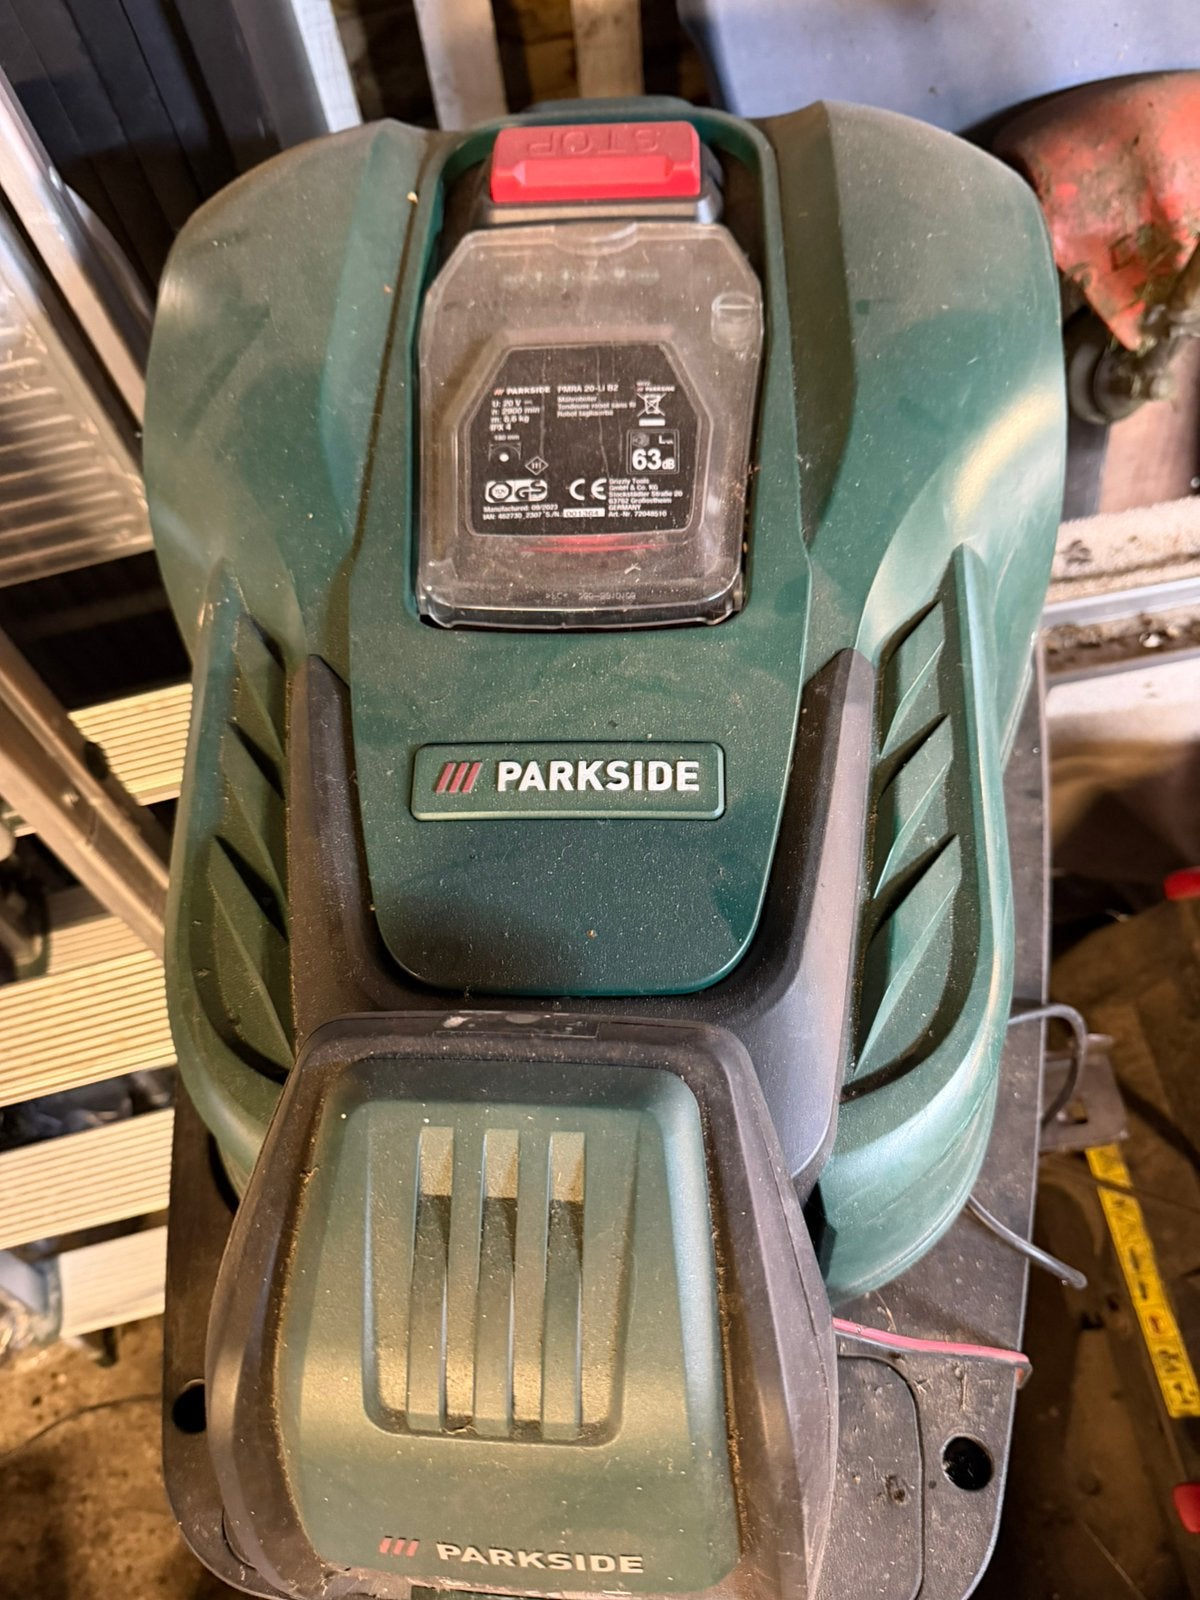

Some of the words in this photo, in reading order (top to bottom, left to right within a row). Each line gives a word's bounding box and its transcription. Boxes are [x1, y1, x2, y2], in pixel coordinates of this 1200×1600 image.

[528, 128, 658, 155] STOP
[506, 386, 551, 396] PARKSIDE
[557, 384, 582, 393] PMRA
[607, 384, 619, 392] B2
[503, 399, 514, 407] 20
[515, 399, 522, 407] V
[632, 448, 662, 470] 63
[662, 457, 676, 470] dB
[569, 478, 607, 500] CE
[496, 760, 700, 792] PARKSIDE
[436, 1541, 645, 1574] PARKSIDE
